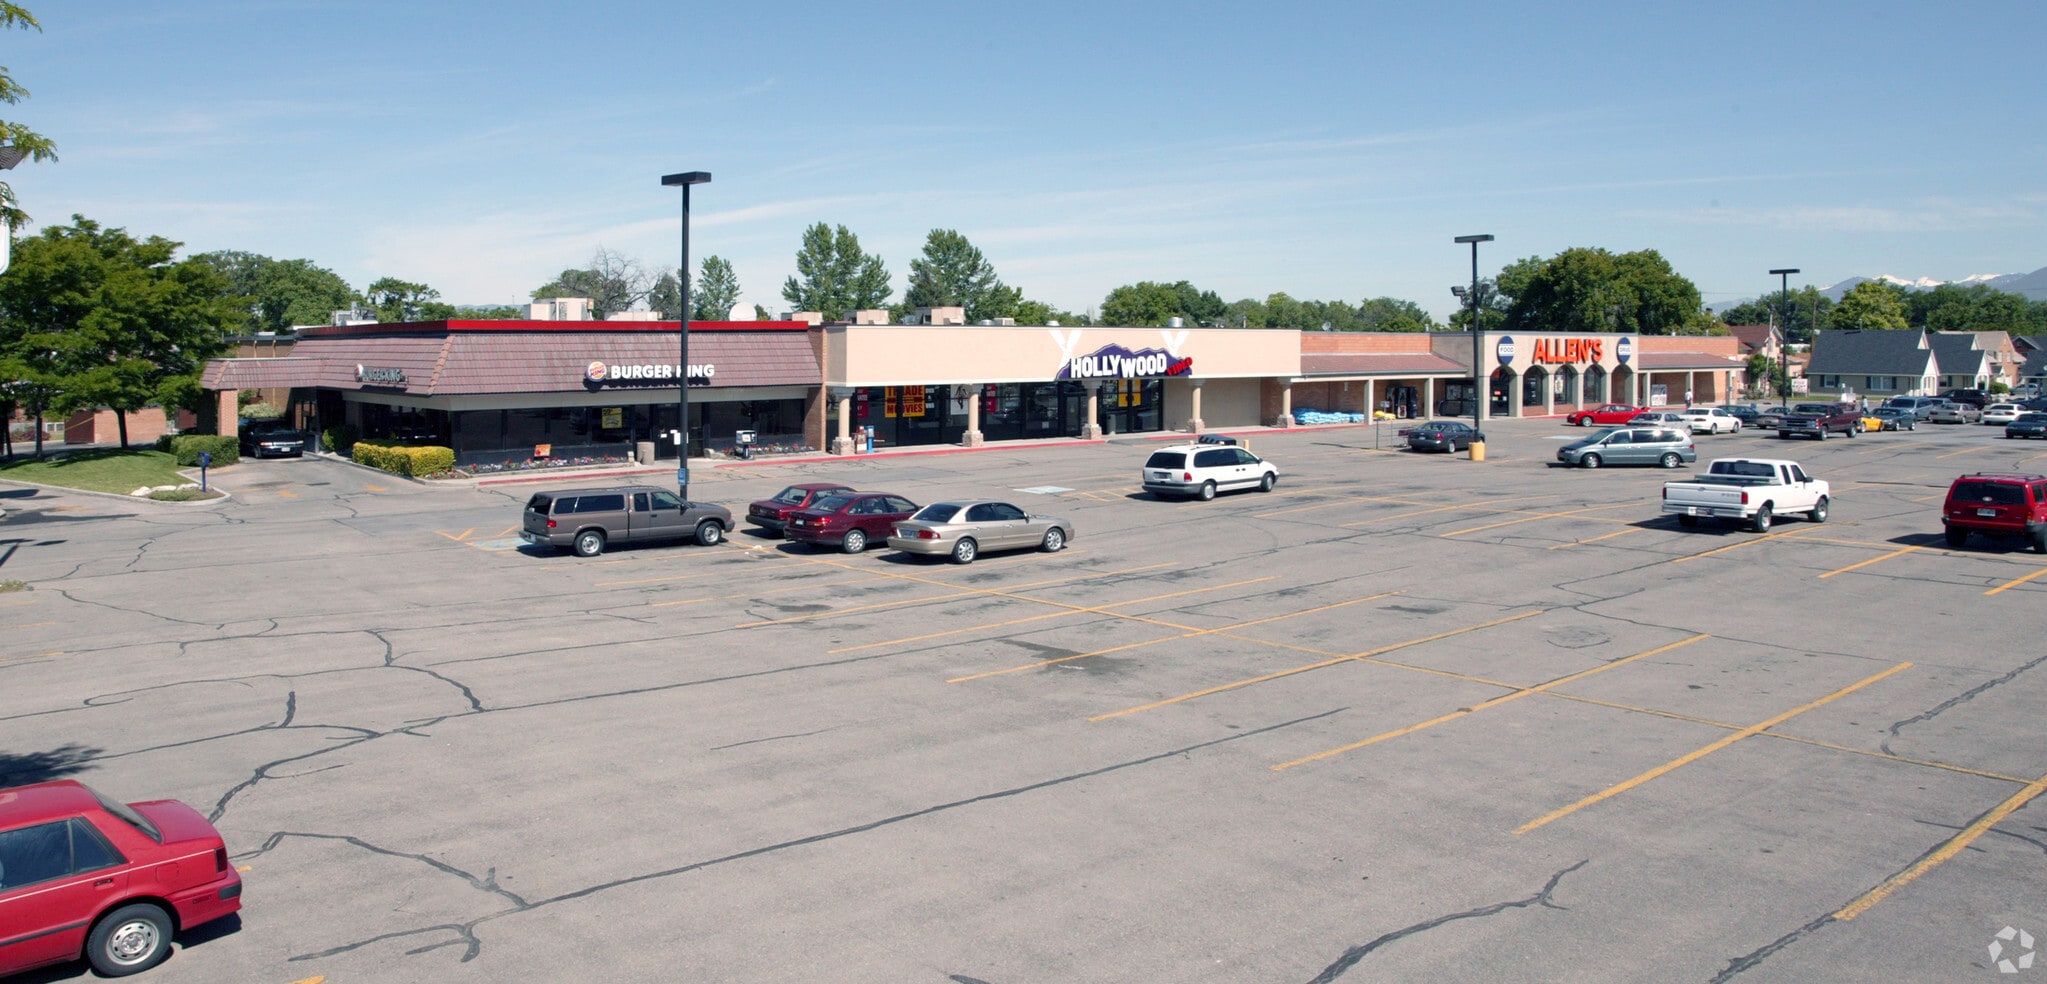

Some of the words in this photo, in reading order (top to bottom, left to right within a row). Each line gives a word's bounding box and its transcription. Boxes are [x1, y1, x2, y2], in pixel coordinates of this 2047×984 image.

[1534, 338, 1603, 363] ALLEN'S
[610, 364, 672, 379] BURGER
[1070, 353, 1168, 379] HOLLYWOOD
